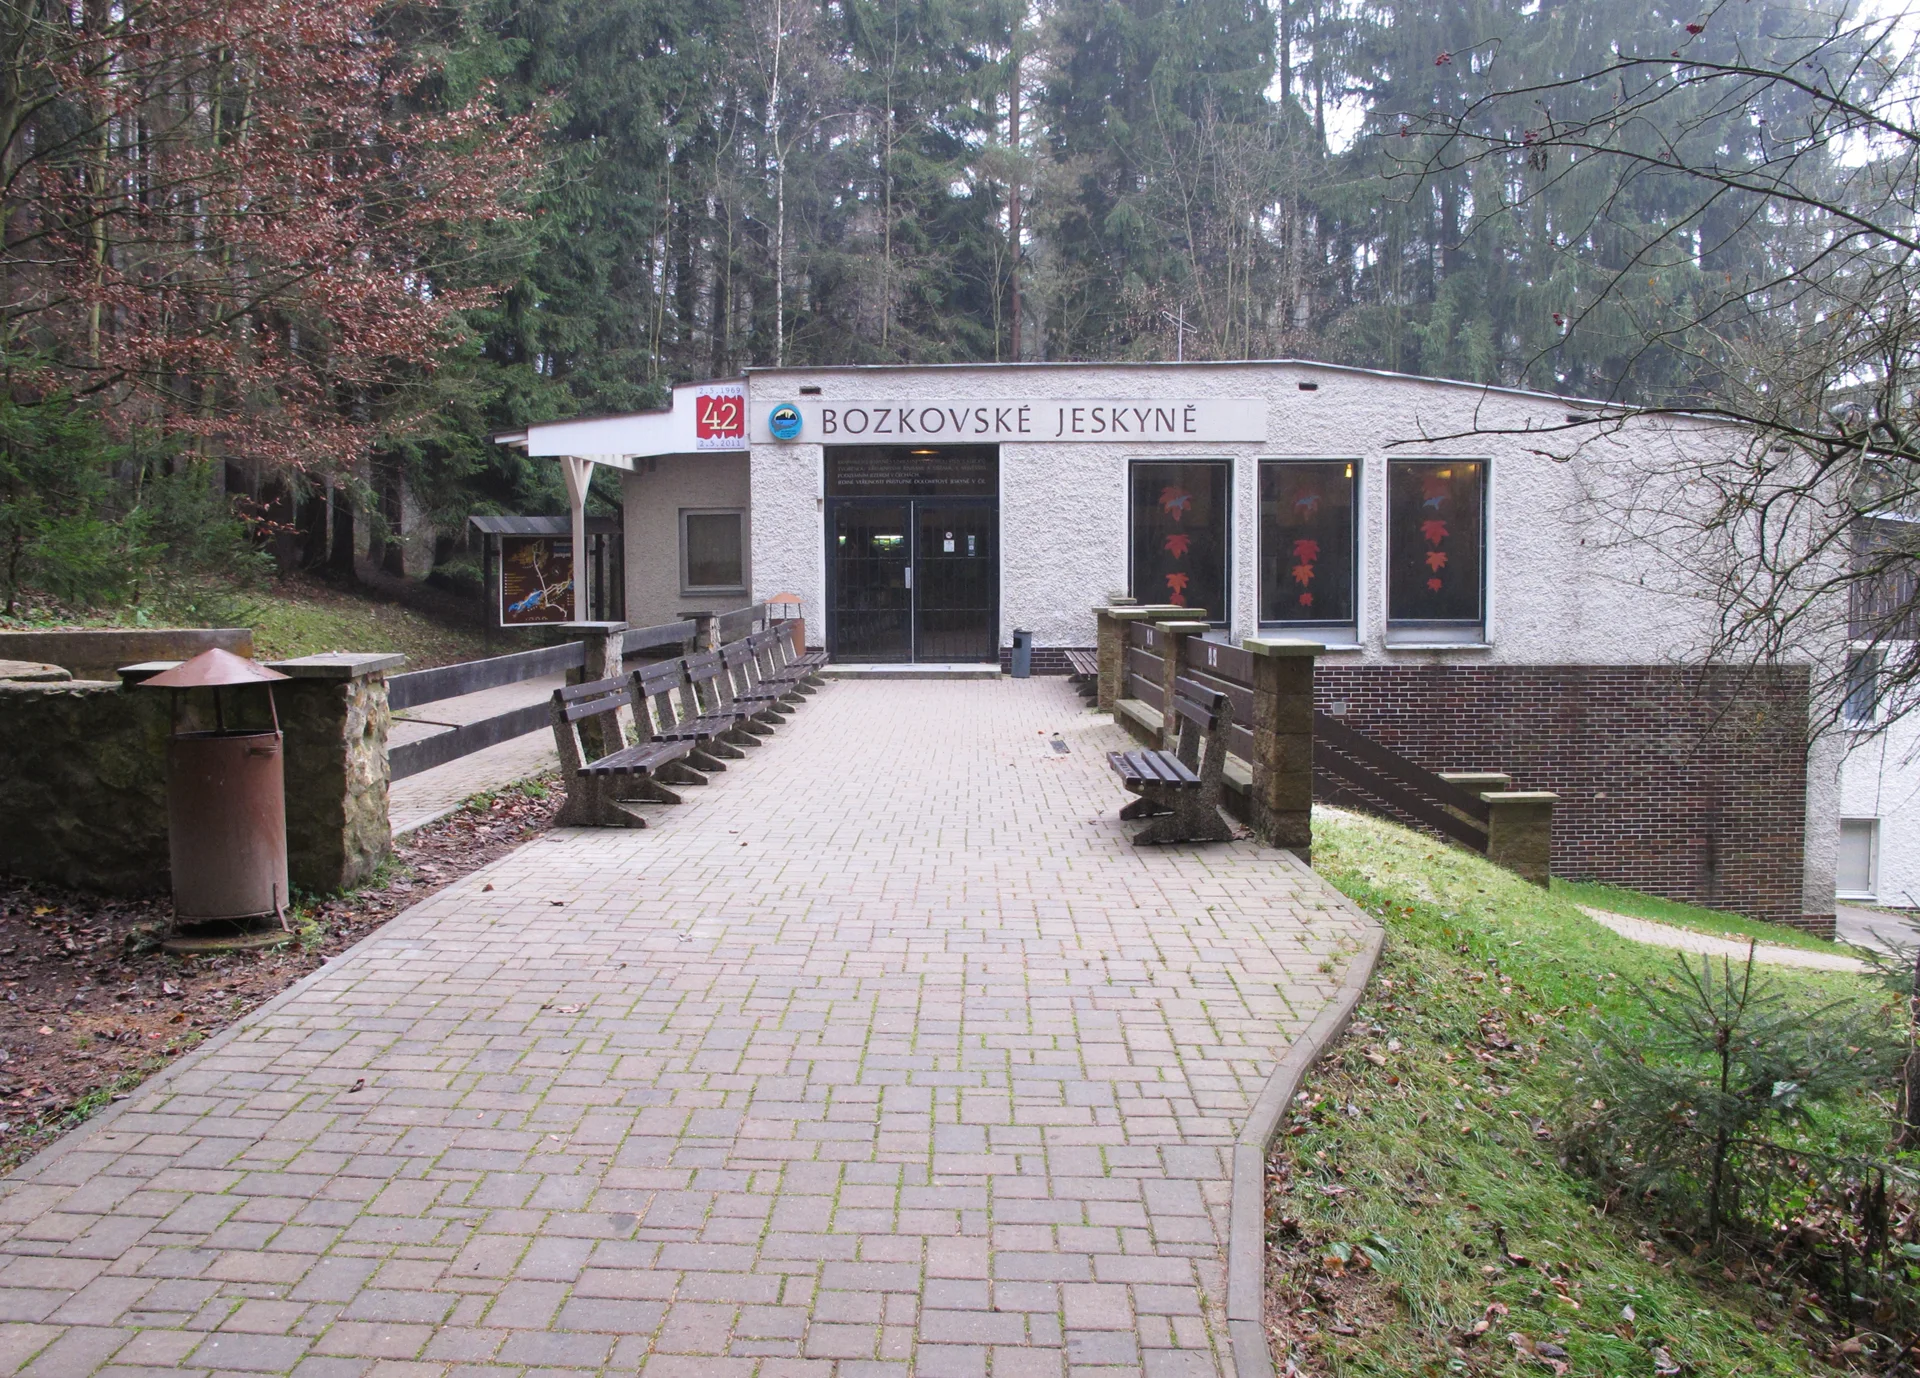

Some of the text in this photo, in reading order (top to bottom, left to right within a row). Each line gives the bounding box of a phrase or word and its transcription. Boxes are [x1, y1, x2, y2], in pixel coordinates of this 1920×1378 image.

[699, 387, 741, 395] 2.5.1969
[701, 402, 738, 430] 42
[823, 403, 1196, 437] BOZKOVSKÉ JESKYNĚ
